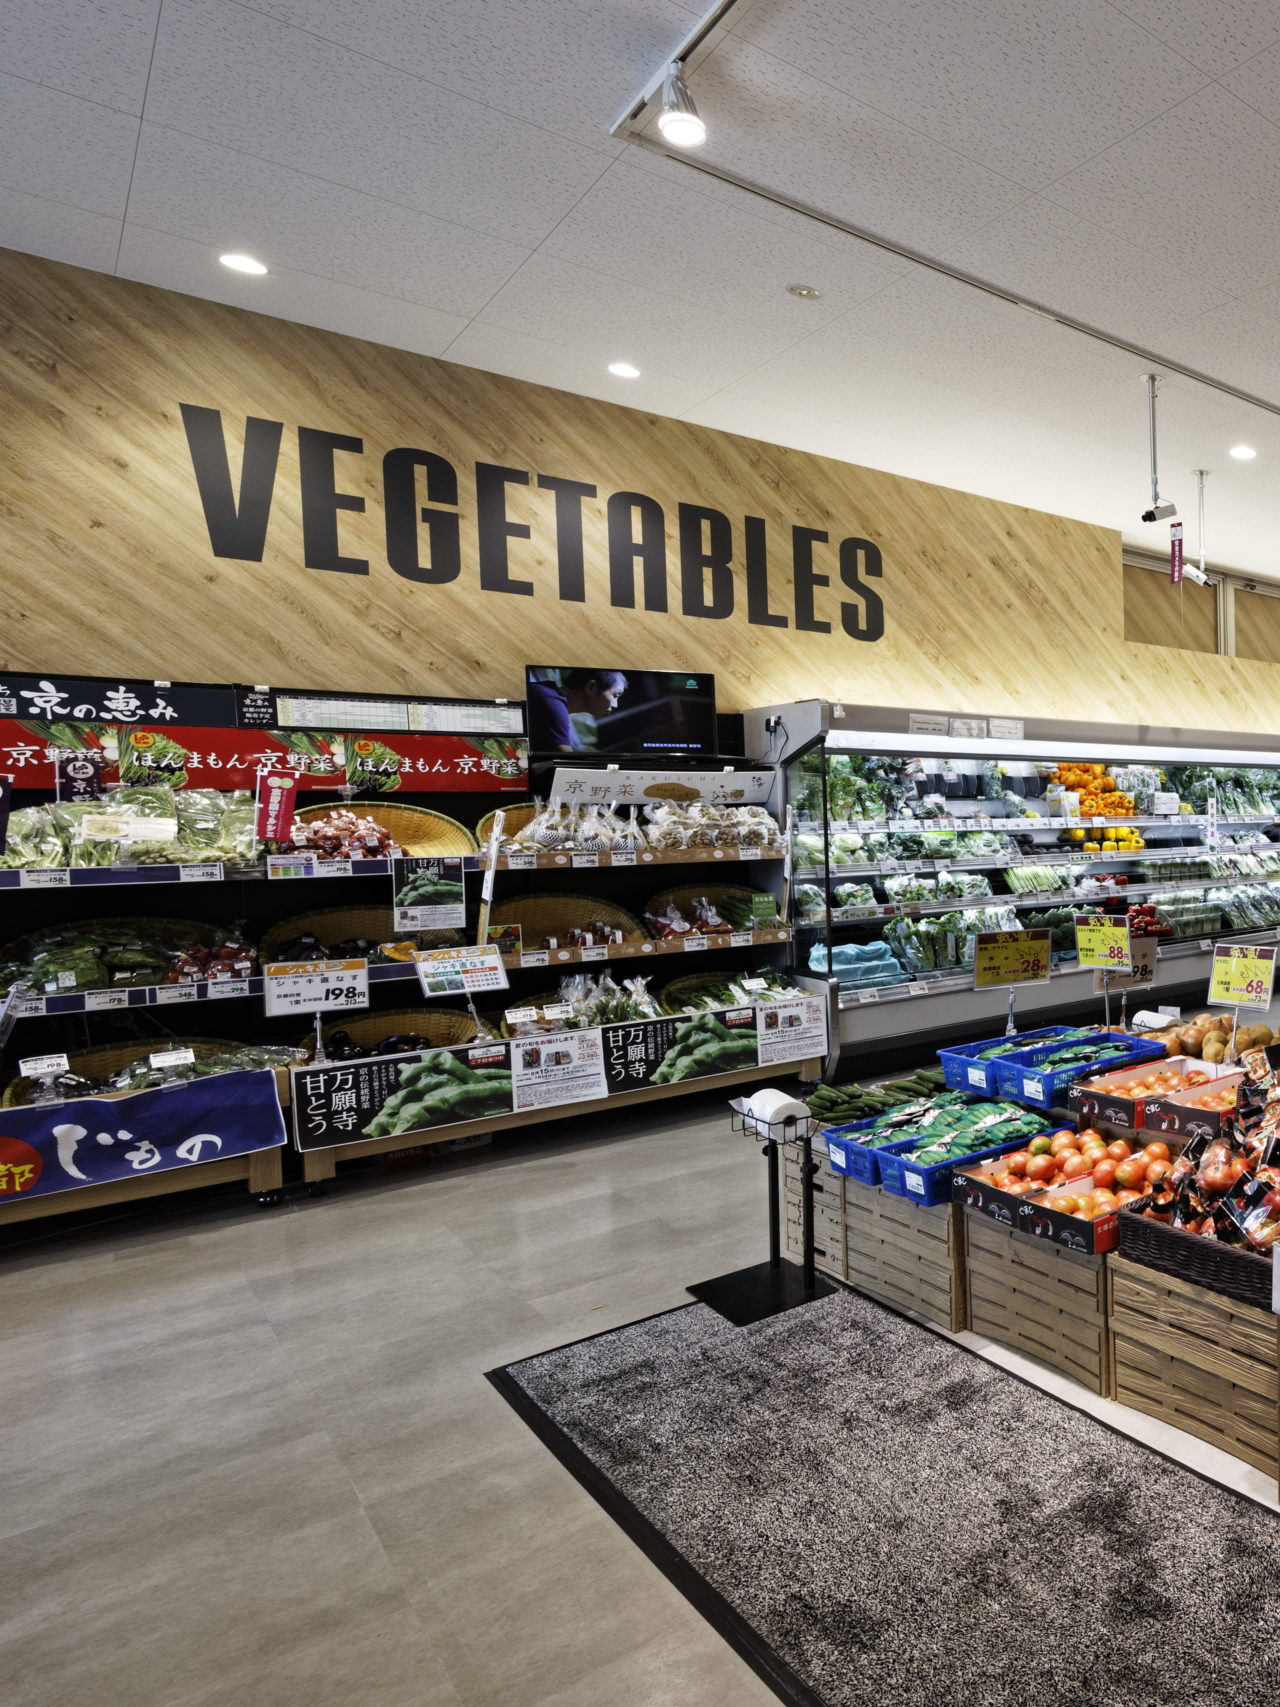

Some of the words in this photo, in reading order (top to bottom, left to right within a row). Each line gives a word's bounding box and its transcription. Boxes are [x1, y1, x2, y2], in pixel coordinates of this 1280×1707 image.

[179, 402, 884, 642] VEGETABLES
[20, 680, 178, 721] 京の恵み
[132, 751, 245, 770] ほんまもん
[253, 748, 335, 771] 京野菜
[356, 756, 450, 773] ほんまもん
[453, 754, 520, 774] 京野菜
[565, 779, 636, 799] 京野菜
[276, 974, 358, 987] シャキ直なす
[432, 960, 487, 972] シャキ直なす
[324, 986, 366, 1001] 198円
[606, 1029, 625, 1081] 甘とう
[625, 1025, 647, 1079] 万願寺
[301, 1074, 329, 1136] 甘とう
[329, 1068, 358, 1131] 万願寺
[359, 1067, 370, 1109] 京の伝統野菜
